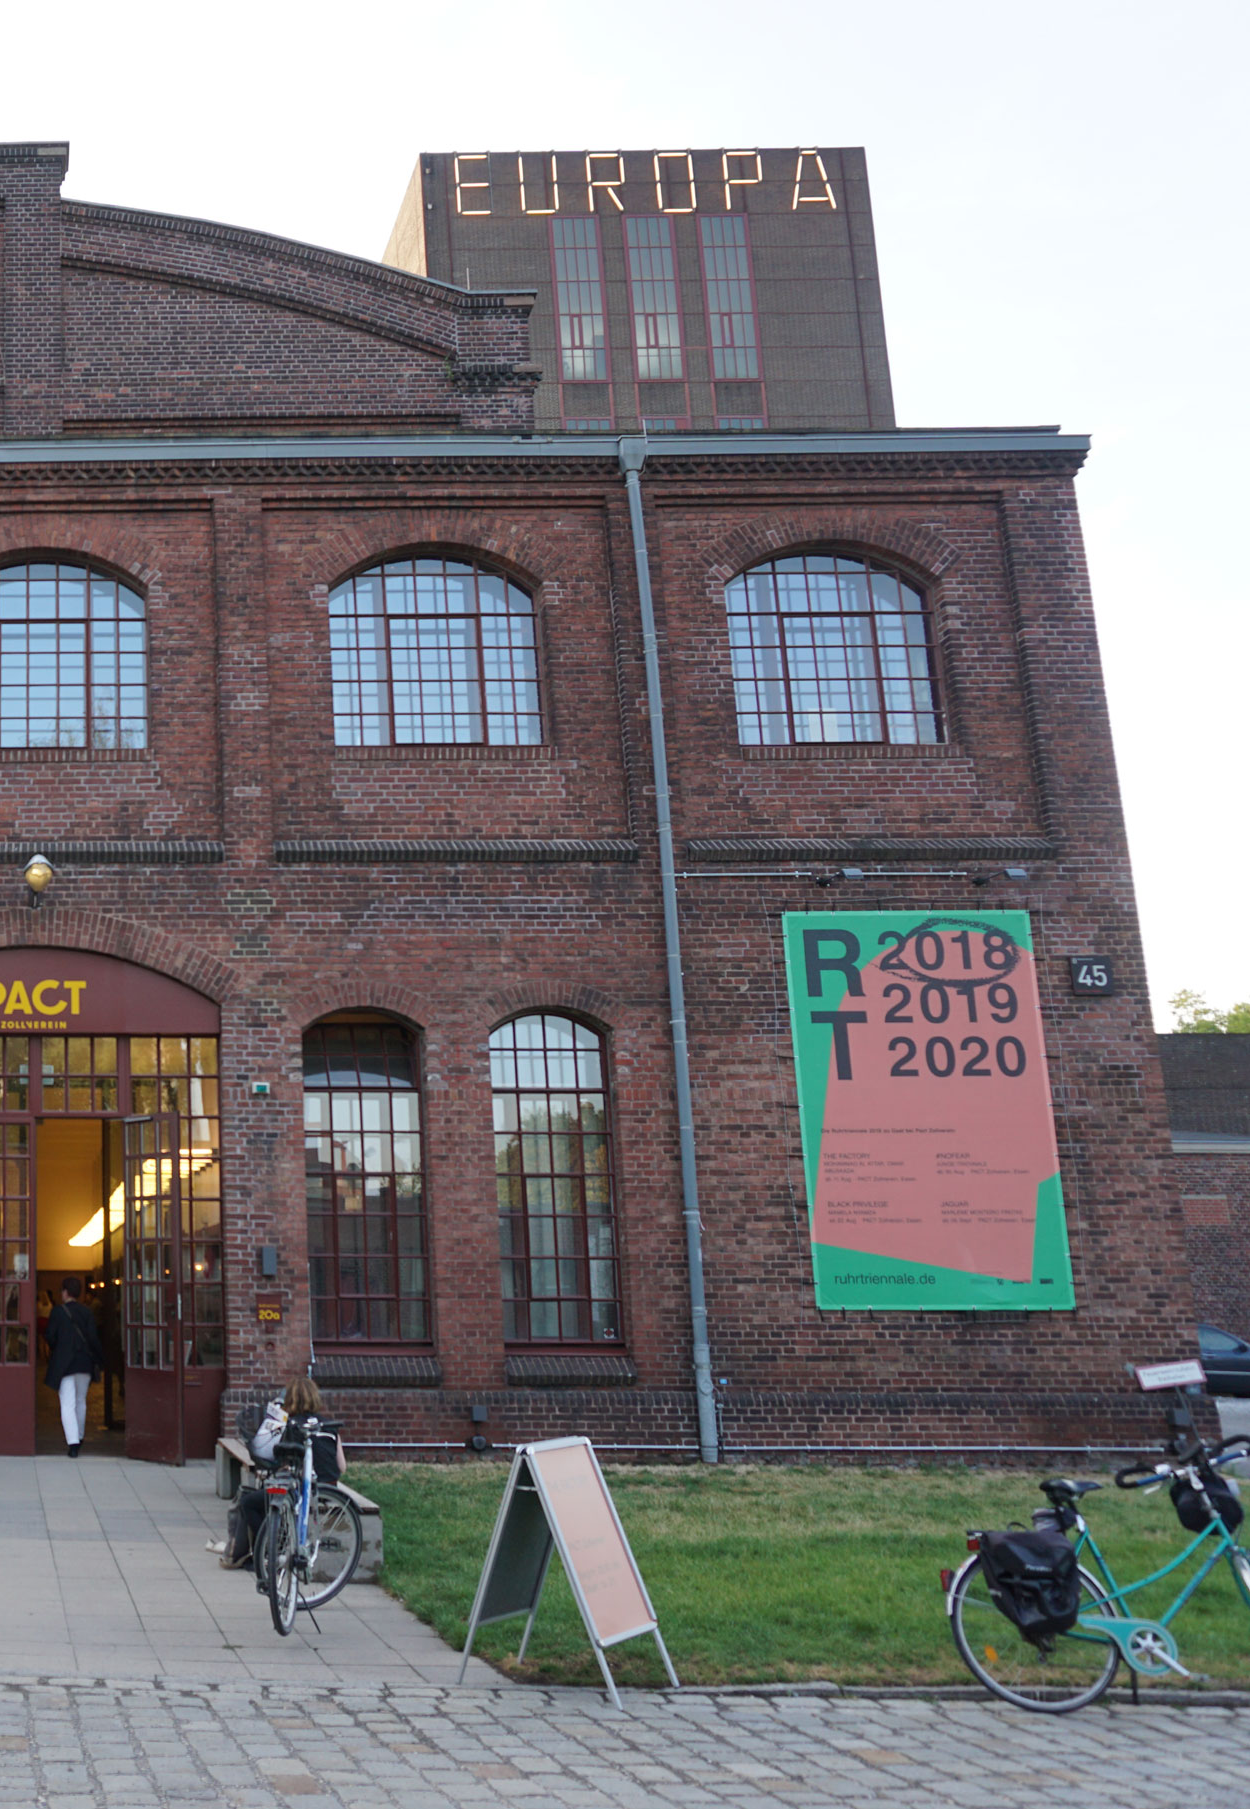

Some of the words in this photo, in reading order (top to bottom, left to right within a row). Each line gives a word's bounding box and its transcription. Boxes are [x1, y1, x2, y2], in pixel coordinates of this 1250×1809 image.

[454, 150, 837, 216] EUROPA
[802, 928, 866, 998] R
[877, 929, 1013, 971] 2018
[1078, 964, 1108, 987] 45
[882, 983, 1019, 1024] 2019
[0, 1020, 67, 1030] ZOLLVEREIN
[810, 1010, 868, 1081] T
[888, 1035, 1027, 1078] 2020
[834, 1273, 937, 1285] ruhrtriennale.de
[258, 1309, 280, 1320] 20a
